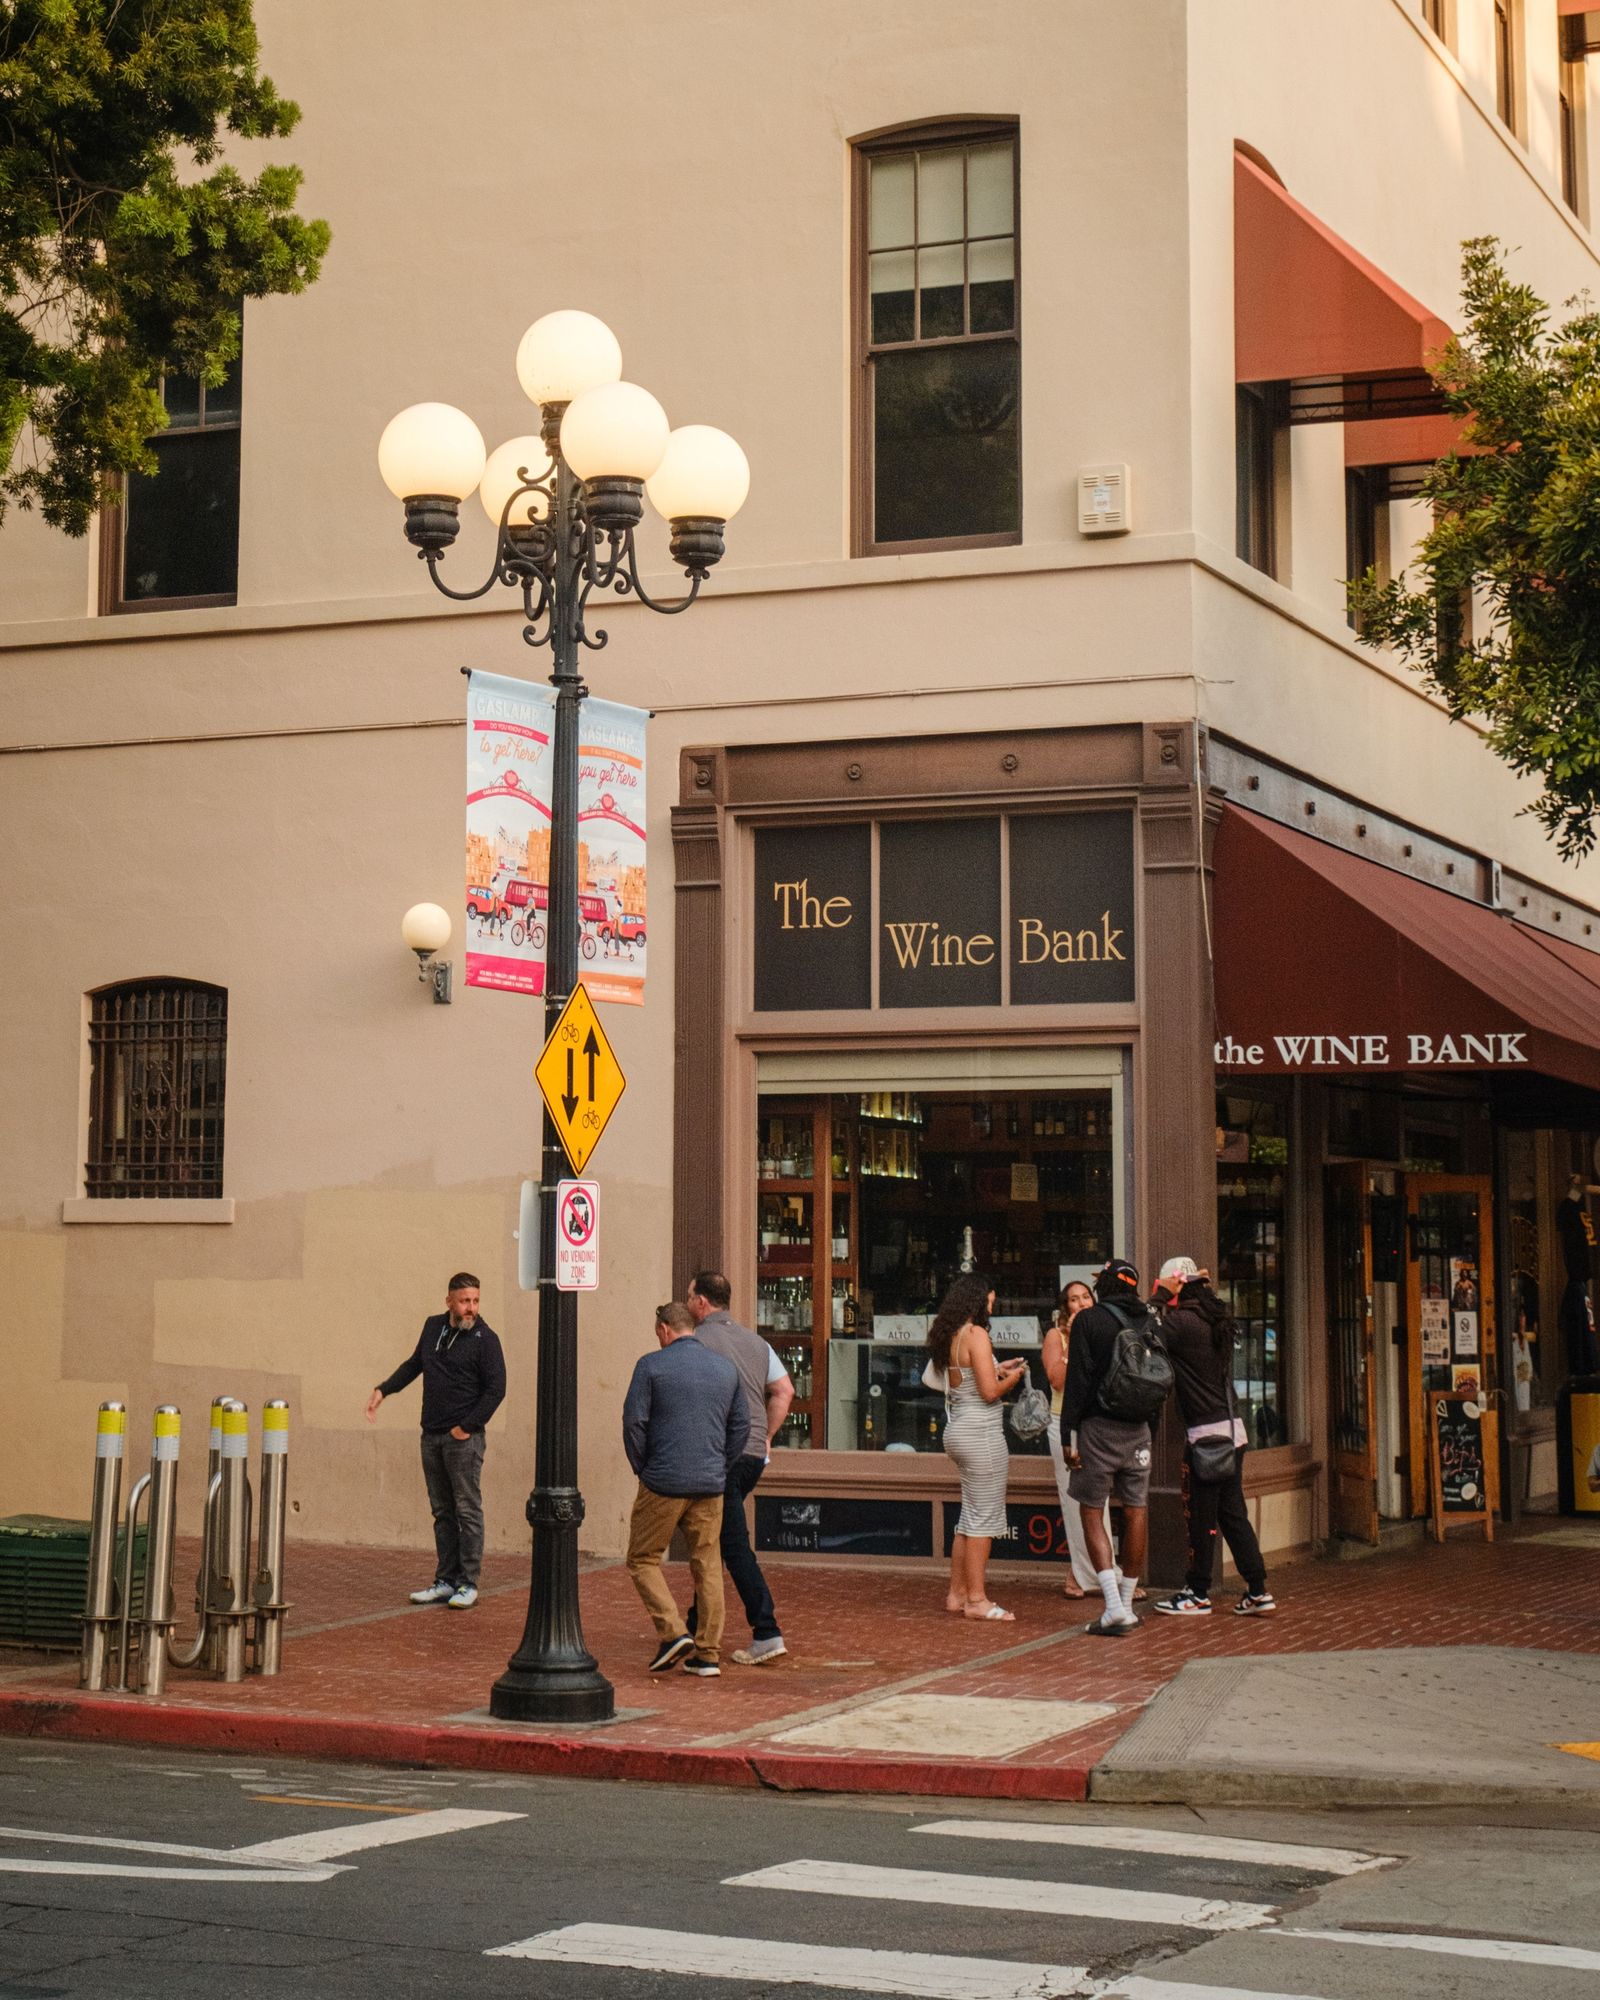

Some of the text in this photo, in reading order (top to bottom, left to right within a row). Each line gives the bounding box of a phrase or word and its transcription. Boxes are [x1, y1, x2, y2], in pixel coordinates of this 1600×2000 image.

[480, 733, 544, 765] to get here?
[577, 762, 637, 790] you get here
[774, 878, 1126, 969] The Wine Bank
[1213, 1033, 1528, 1065] the WINE BANK
[560, 1250, 595, 1263] NO VENDING
[571, 1265, 586, 1278] ZONE
[888, 1331, 911, 1340] ALTO
[996, 1332, 1020, 1341] ALTO
